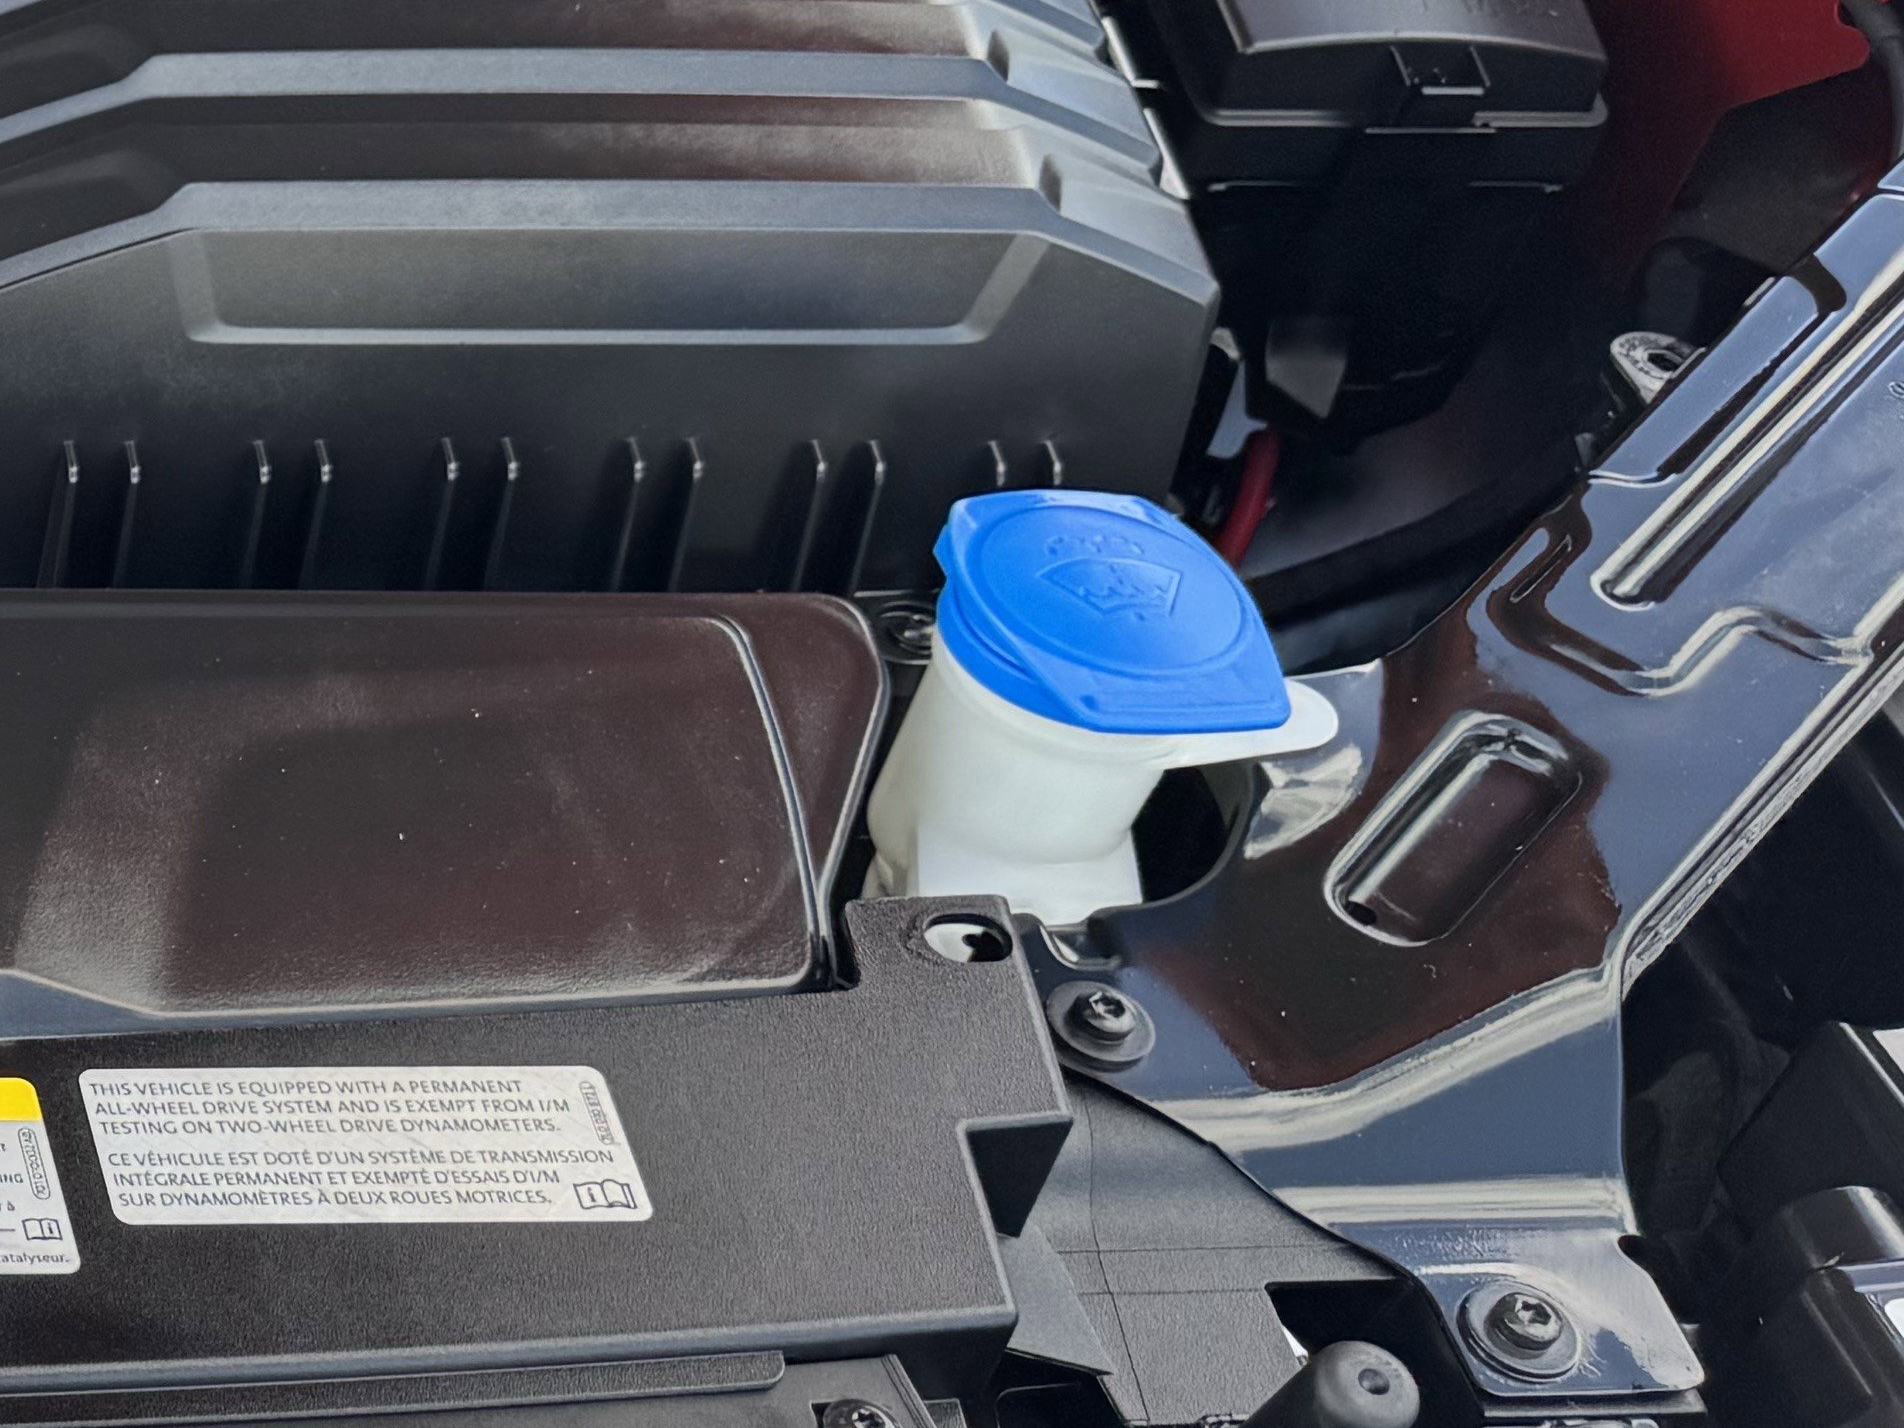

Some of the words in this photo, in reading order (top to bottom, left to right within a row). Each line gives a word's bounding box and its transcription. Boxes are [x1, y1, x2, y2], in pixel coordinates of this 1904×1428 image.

[90, 1083, 131, 1095] THIS
[134, 1082, 212, 1095] VEHICLE
[218, 1082, 233, 1095] IS
[239, 1081, 331, 1097] EQUIPPED
[336, 1081, 386, 1094] WITH
[392, 1081, 406, 1093] A
[411, 1080, 522, 1093] PERMANENT
[95, 1102, 198, 1115] ALL-WHEEL
[202, 1101, 258, 1114] DRIVE
[263, 1101, 331, 1113] SYSTEM
[338, 1100, 379, 1113] AND
[385, 1100, 401, 1113] IS
[406, 1100, 476, 1113] EXEMPT
[482, 1099, 534, 1112] FROM
[540, 1099, 569, 1112] I/M
[100, 1122, 177, 1134] TESTING
[183, 1121, 211, 1133] ON
[216, 1121, 336, 1133] TWO-WHEEL
[340, 1119, 398, 1132] DRIVE
[402, 1119, 561, 1132] DYNAMOMETERS.
[108, 1153, 131, 1166] CE
[133, 1150, 224, 1166] VÉHICULE
[229, 1152, 257, 1165] EST
[263, 1150, 313, 1165] DOTÉ
[317, 1149, 364, 1164] D'UN
[369, 1149, 445, 1164] SYSTÈME
[451, 1150, 475, 1164] DE
[477, 1150, 614, 1163] TRANSMISSION
[114, 1171, 211, 1186] INTÉGRALE
[214, 1172, 322, 1186] PERMANENT
[329, 1171, 347, 1185] ET
[353, 1169, 431, 1185] EXEMPTÉ
[435, 1170, 509, 1184] D'ESSAIS
[119, 1192, 156, 1206] SUR
[161, 1189, 313, 1206] DYNAMOMÈTRES
[318, 1189, 330, 1203] À
[334, 1191, 387, 1205] DEUX
[391, 1191, 451, 1205] ROUES
[457, 1190, 551, 1204] MOTRICES.
